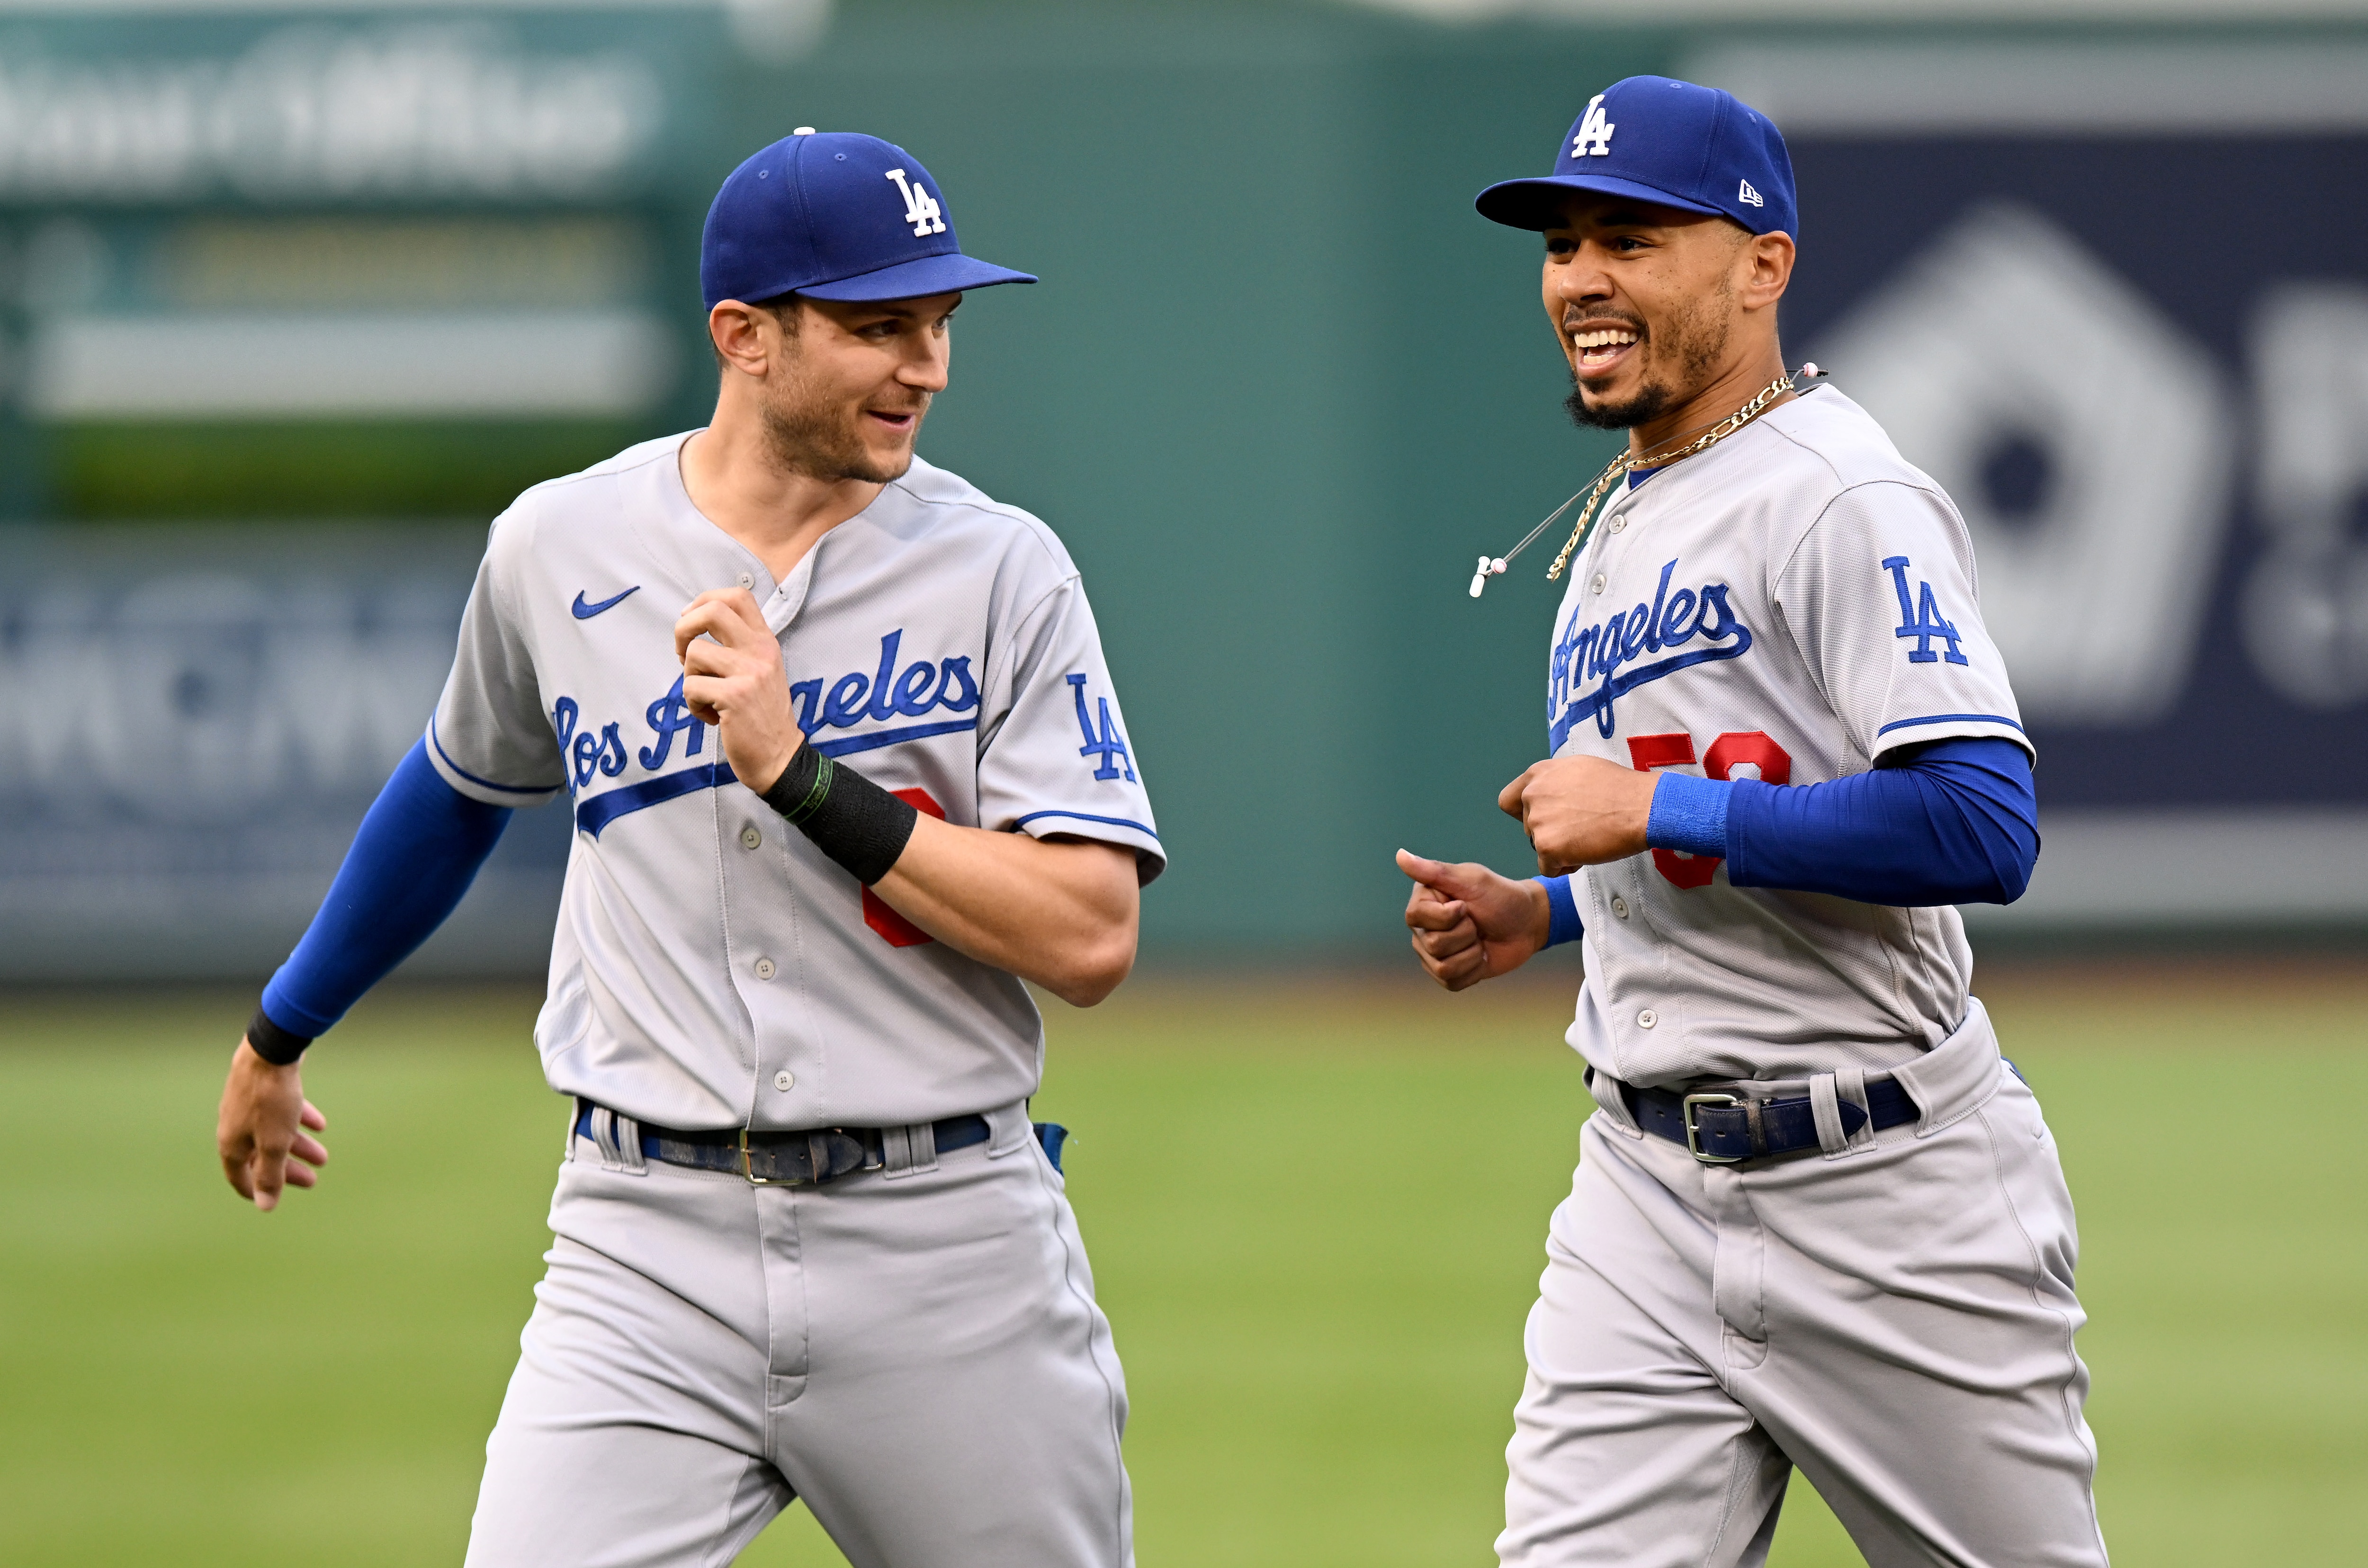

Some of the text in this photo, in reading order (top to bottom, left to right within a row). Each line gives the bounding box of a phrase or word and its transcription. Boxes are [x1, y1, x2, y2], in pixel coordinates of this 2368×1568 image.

[1571, 95, 1615, 158] LA
[886, 168, 946, 237] LA
[1548, 558, 1743, 739] Angeles
[1882, 556, 1968, 666] LA
[552, 696, 628, 797] Los
[1066, 672, 1136, 782] LA
